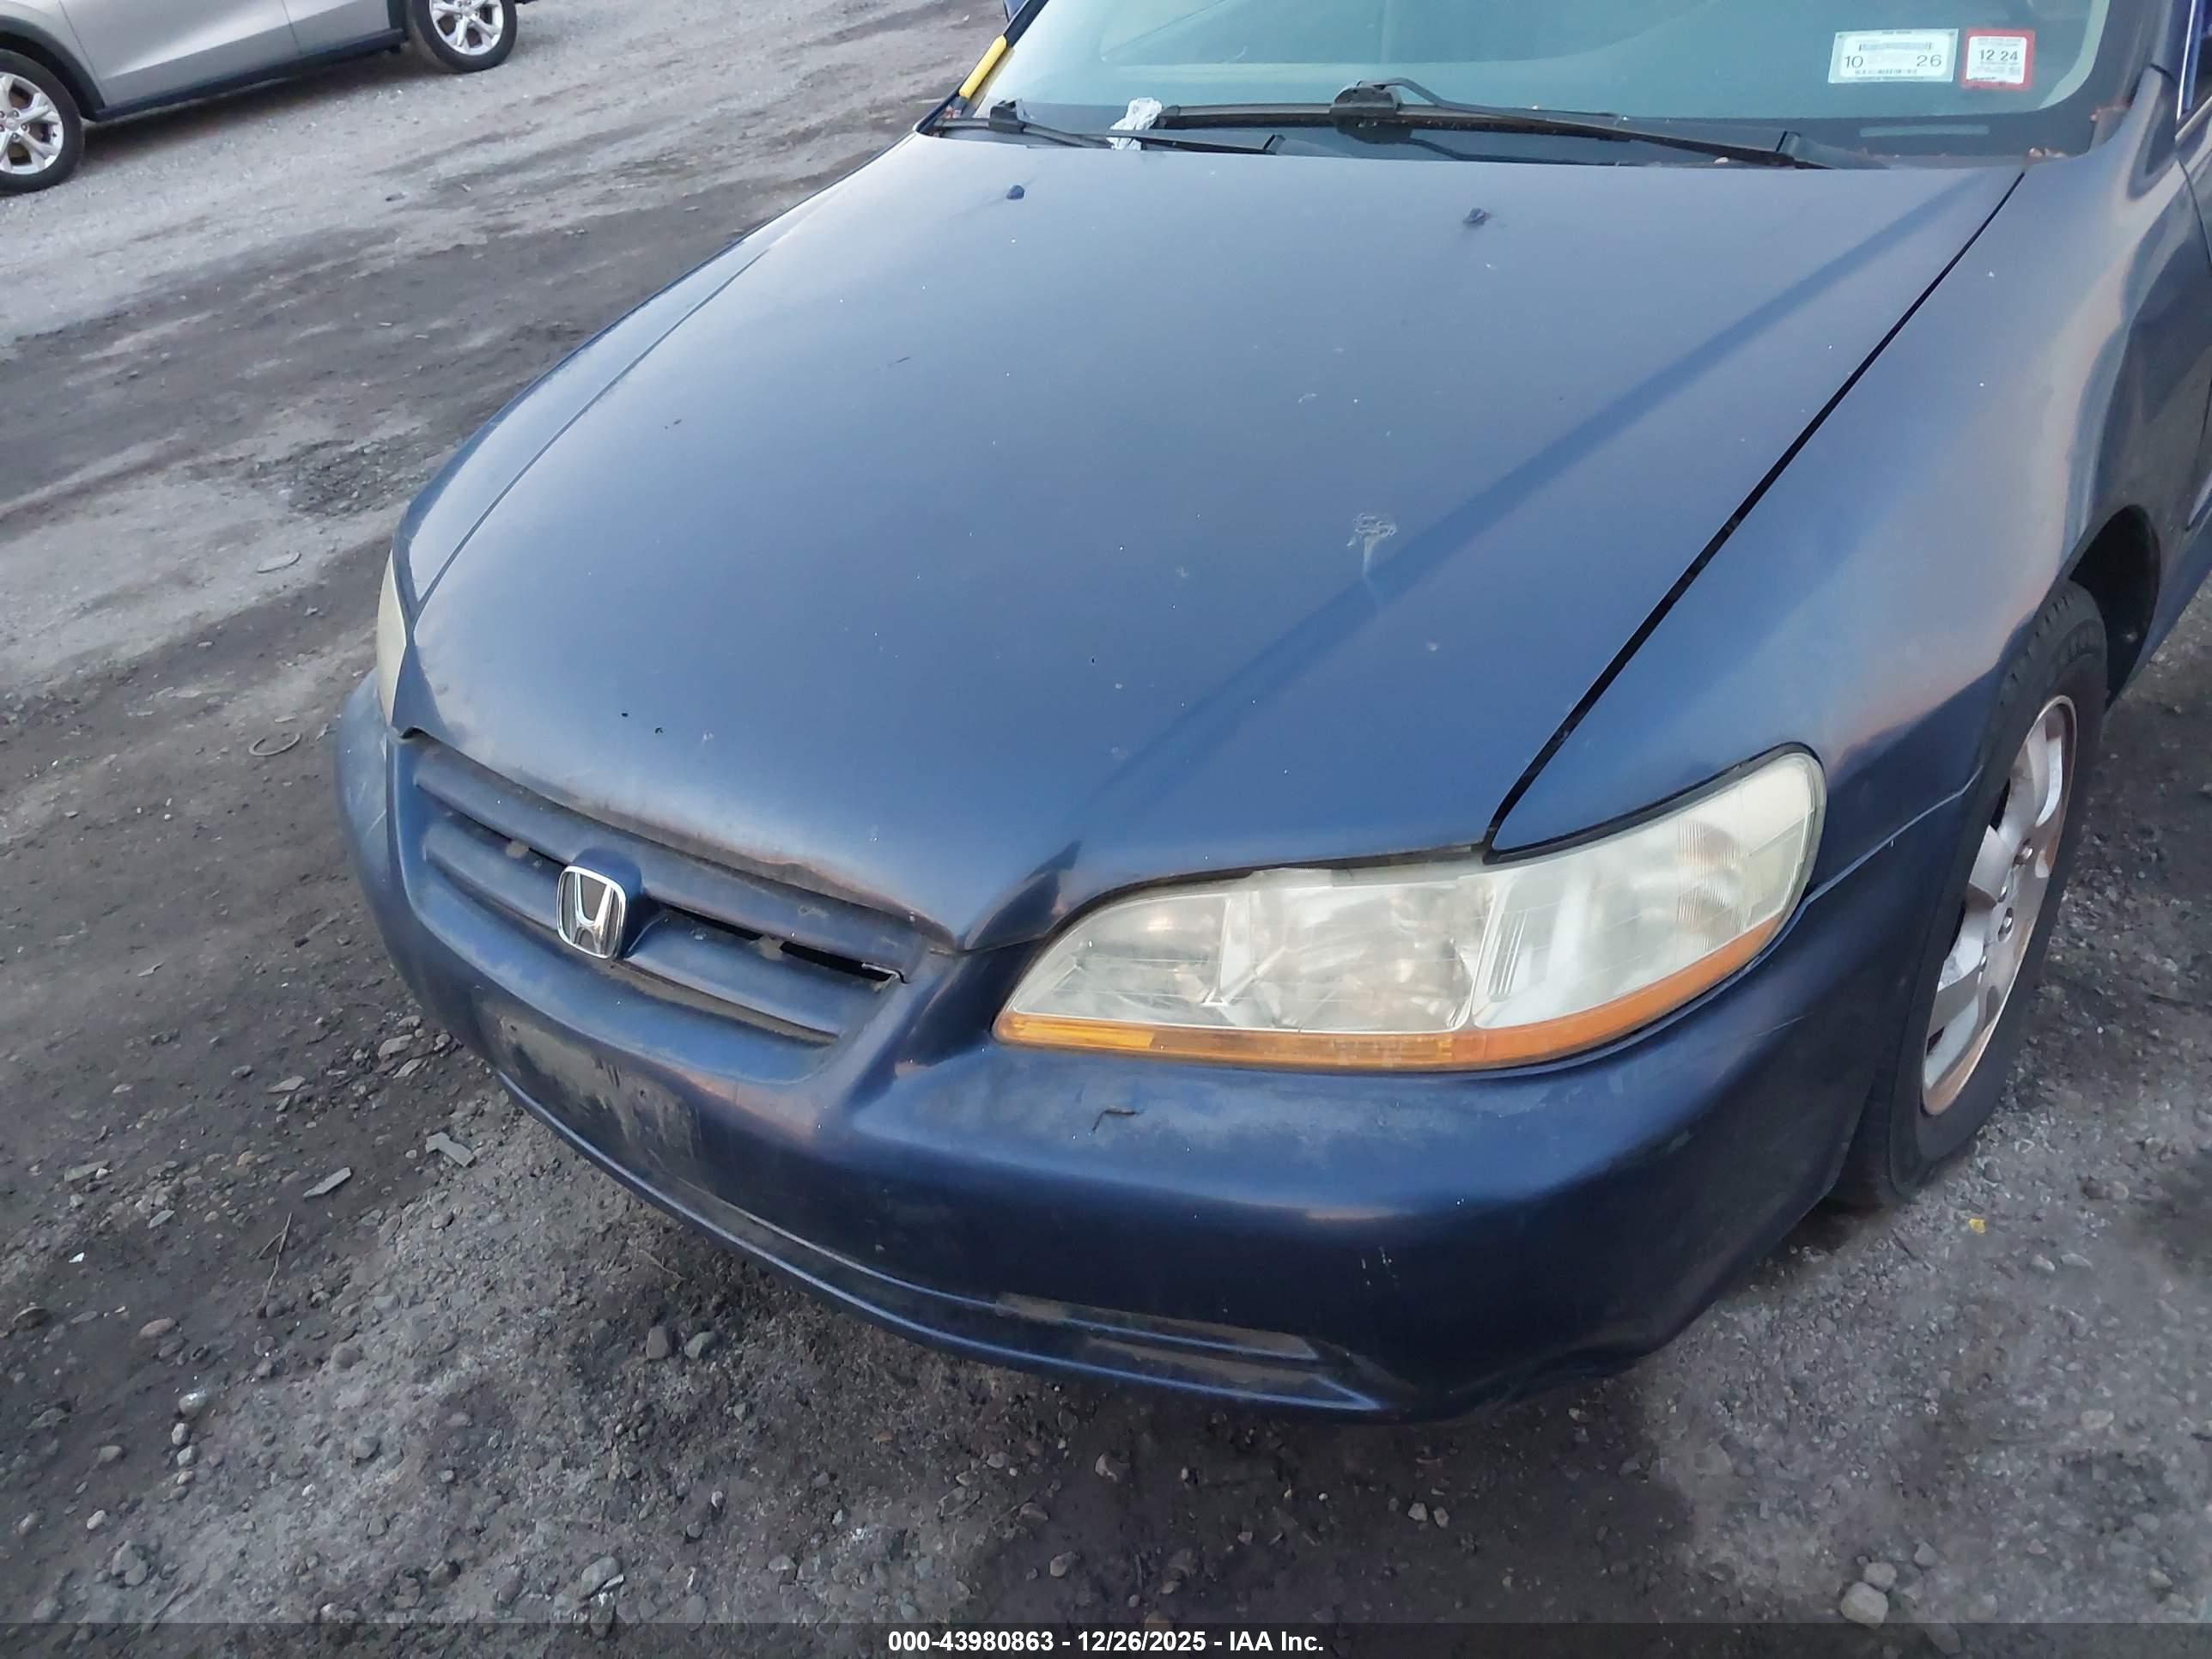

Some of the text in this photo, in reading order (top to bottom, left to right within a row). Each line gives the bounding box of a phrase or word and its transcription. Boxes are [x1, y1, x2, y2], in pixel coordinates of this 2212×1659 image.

[1844, 54, 1942, 68] 10 26
[1979, 49, 2018, 61] 12 24
